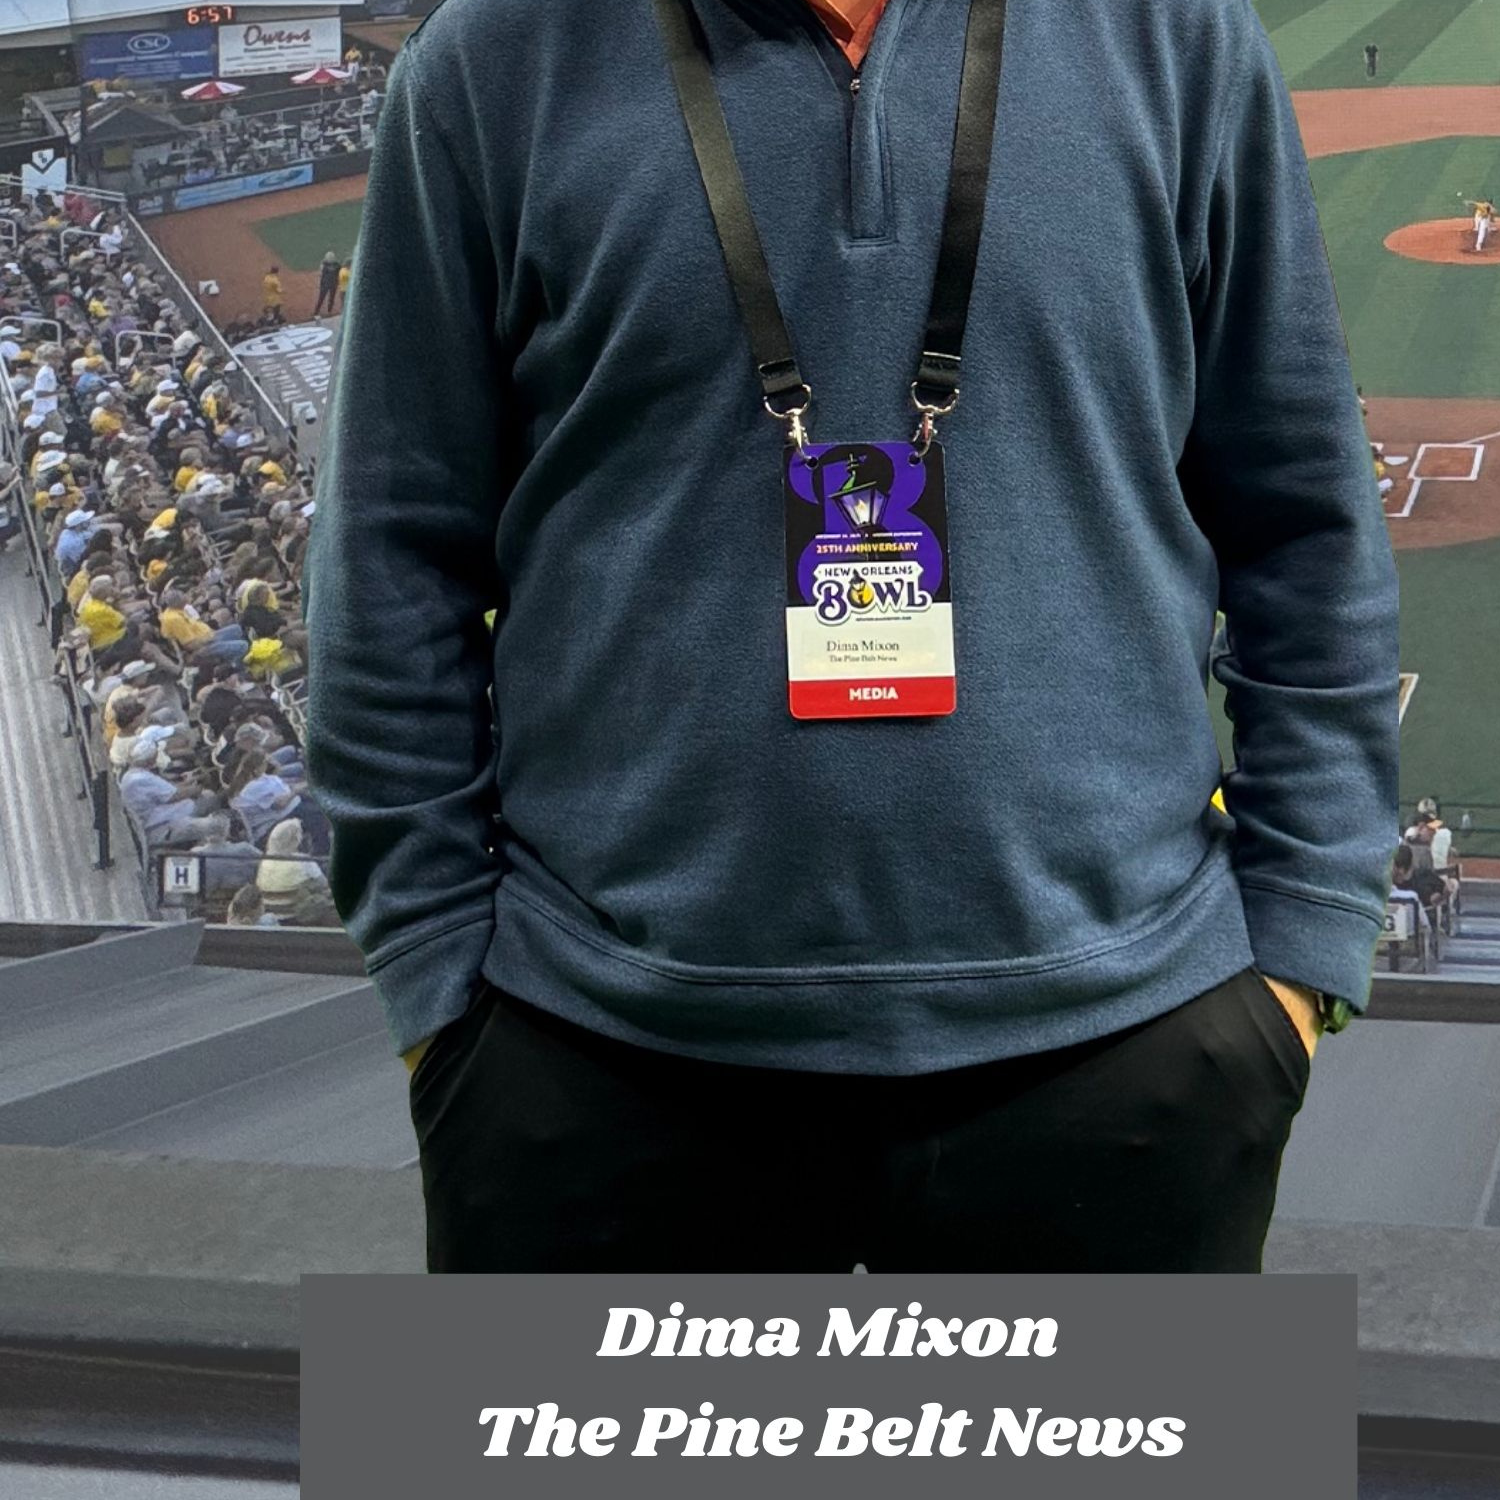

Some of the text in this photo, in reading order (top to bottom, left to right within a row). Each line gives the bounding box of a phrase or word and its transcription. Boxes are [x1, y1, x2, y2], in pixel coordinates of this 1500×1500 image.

[187, 5, 233, 25] 6:57
[243, 25, 311, 46] Owens
[816, 542, 918, 554] 25TH ANNIVERSARY
[824, 565, 913, 577] NEW ORLEANS
[816, 579, 929, 621] BOWL
[827, 640, 900, 652] Dima Mixon
[848, 687, 899, 701] MEDIA
[175, 867, 188, 884] H
